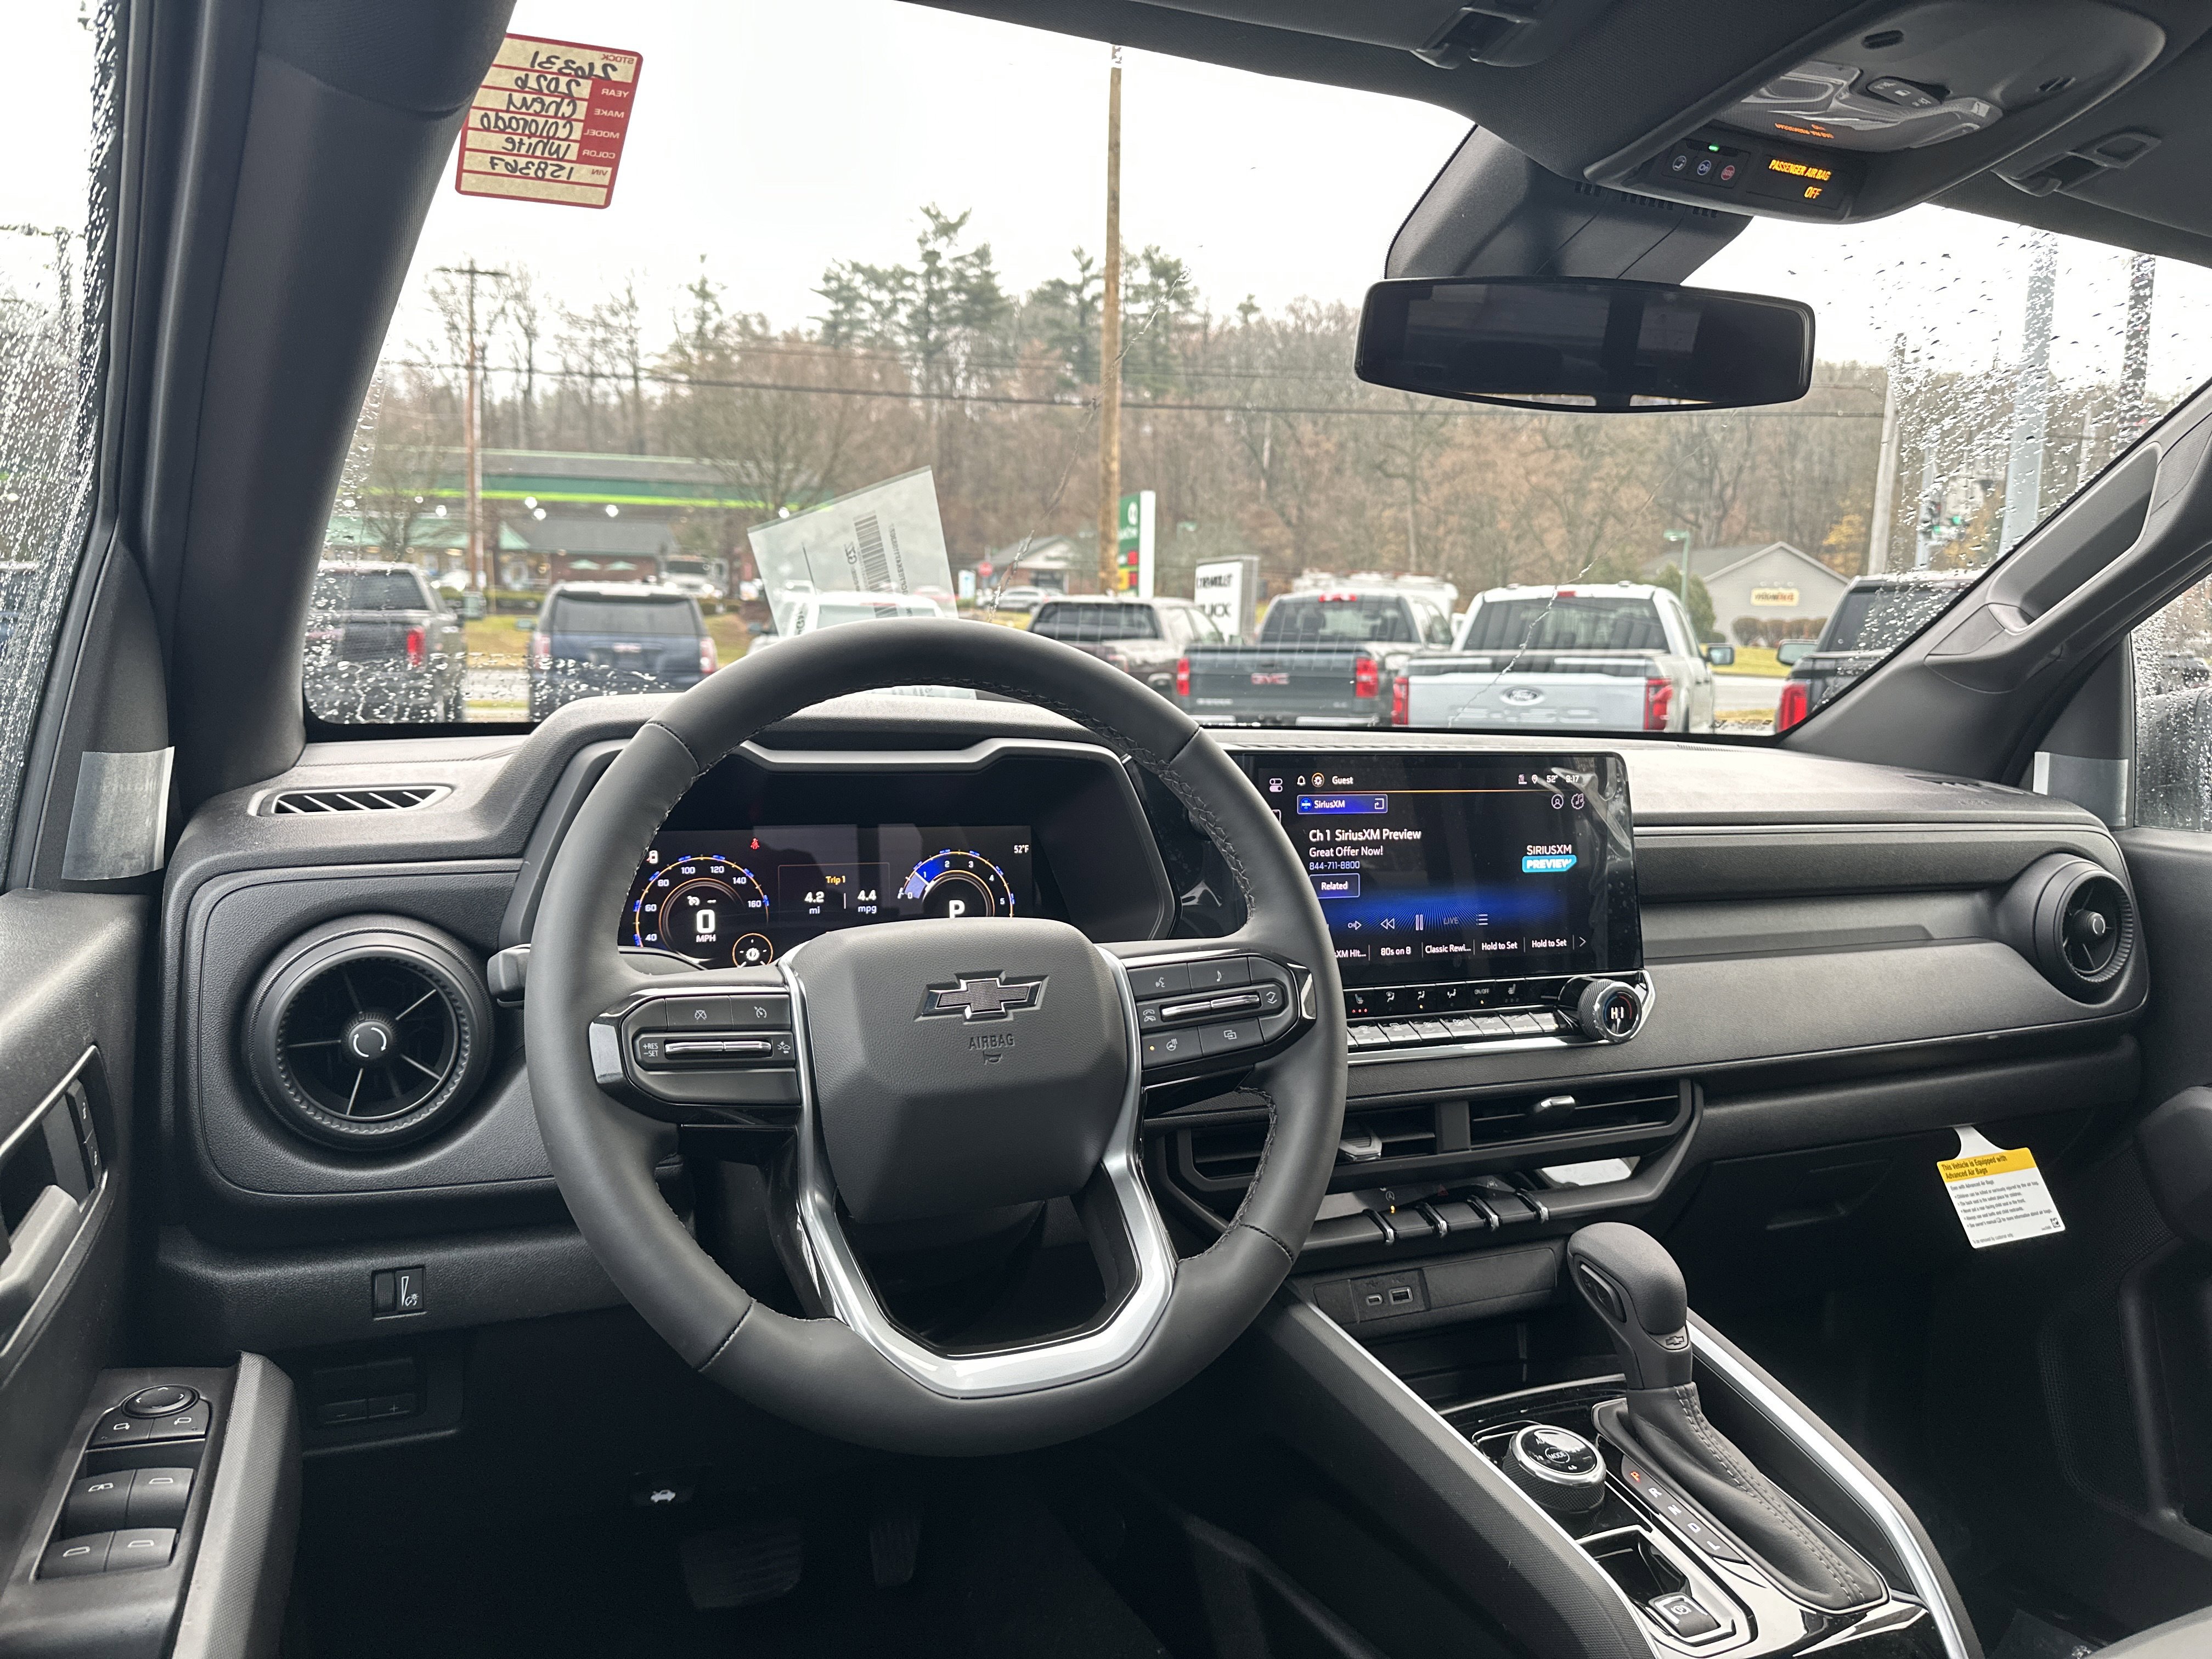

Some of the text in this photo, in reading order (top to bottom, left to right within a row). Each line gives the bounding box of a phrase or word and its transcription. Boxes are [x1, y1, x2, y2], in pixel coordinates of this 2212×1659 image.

[1769, 159, 1805, 176] PASSENGER
[1804, 186, 1822, 199] OFF
[1251, 673, 1290, 685] GMC
[1332, 776, 1353, 785] Guest
[1566, 775, 1579, 783] 9:17
[1314, 800, 1345, 809] SiriusXM
[1309, 828, 1421, 842] Ch 1 SiriusXM Preview
[1013, 844, 1029, 854] 52°F
[1309, 845, 1384, 857] Great Offer Now!
[1527, 844, 1572, 855] SIRIUSXM
[944, 860, 950, 868] 2
[968, 860, 974, 868] 3
[1309, 860, 1360, 871] 844-711-8800
[1526, 859, 1572, 869] PREVIEW
[681, 866, 696, 874] 100
[710, 865, 725, 874] 120
[826, 875, 840, 884] Trip
[923, 871, 927, 879] 1
[657, 879, 670, 887] 80
[732, 876, 747, 885] 140
[1321, 881, 1348, 890] Related
[804, 891, 825, 903] 4.2
[857, 889, 877, 901] 4.4
[907, 891, 913, 900] 0
[645, 904, 657, 912] 60
[747, 900, 761, 908] 160
[809, 906, 820, 915] mi
[858, 905, 877, 915] mpg
[949, 900, 966, 919] P
[696, 909, 715, 934] 0
[1443, 917, 1459, 925] LIVE
[645, 933, 657, 942] 40
[696, 934, 716, 943] MPH
[1425, 943, 1471, 954] Classic Rewi...
[1481, 942, 1498, 951] Hold
[1506, 941, 1518, 950] Set
[1532, 939, 1548, 949] Hold
[1556, 939, 1567, 947] Set
[1380, 947, 1395, 956] 80s
[1405, 946, 1412, 955] 8
[1610, 1006, 1624, 1020] HI
[969, 1033, 1015, 1051] AIRBAG
[1941, 1164, 1951, 1173] This
[1974, 1156, 1996, 1166] Equipped
[1945, 1170, 1967, 1178] Advanced
[1548, 1451, 1567, 1459] MODE
[1630, 1471, 1720, 1551] P R N D L
